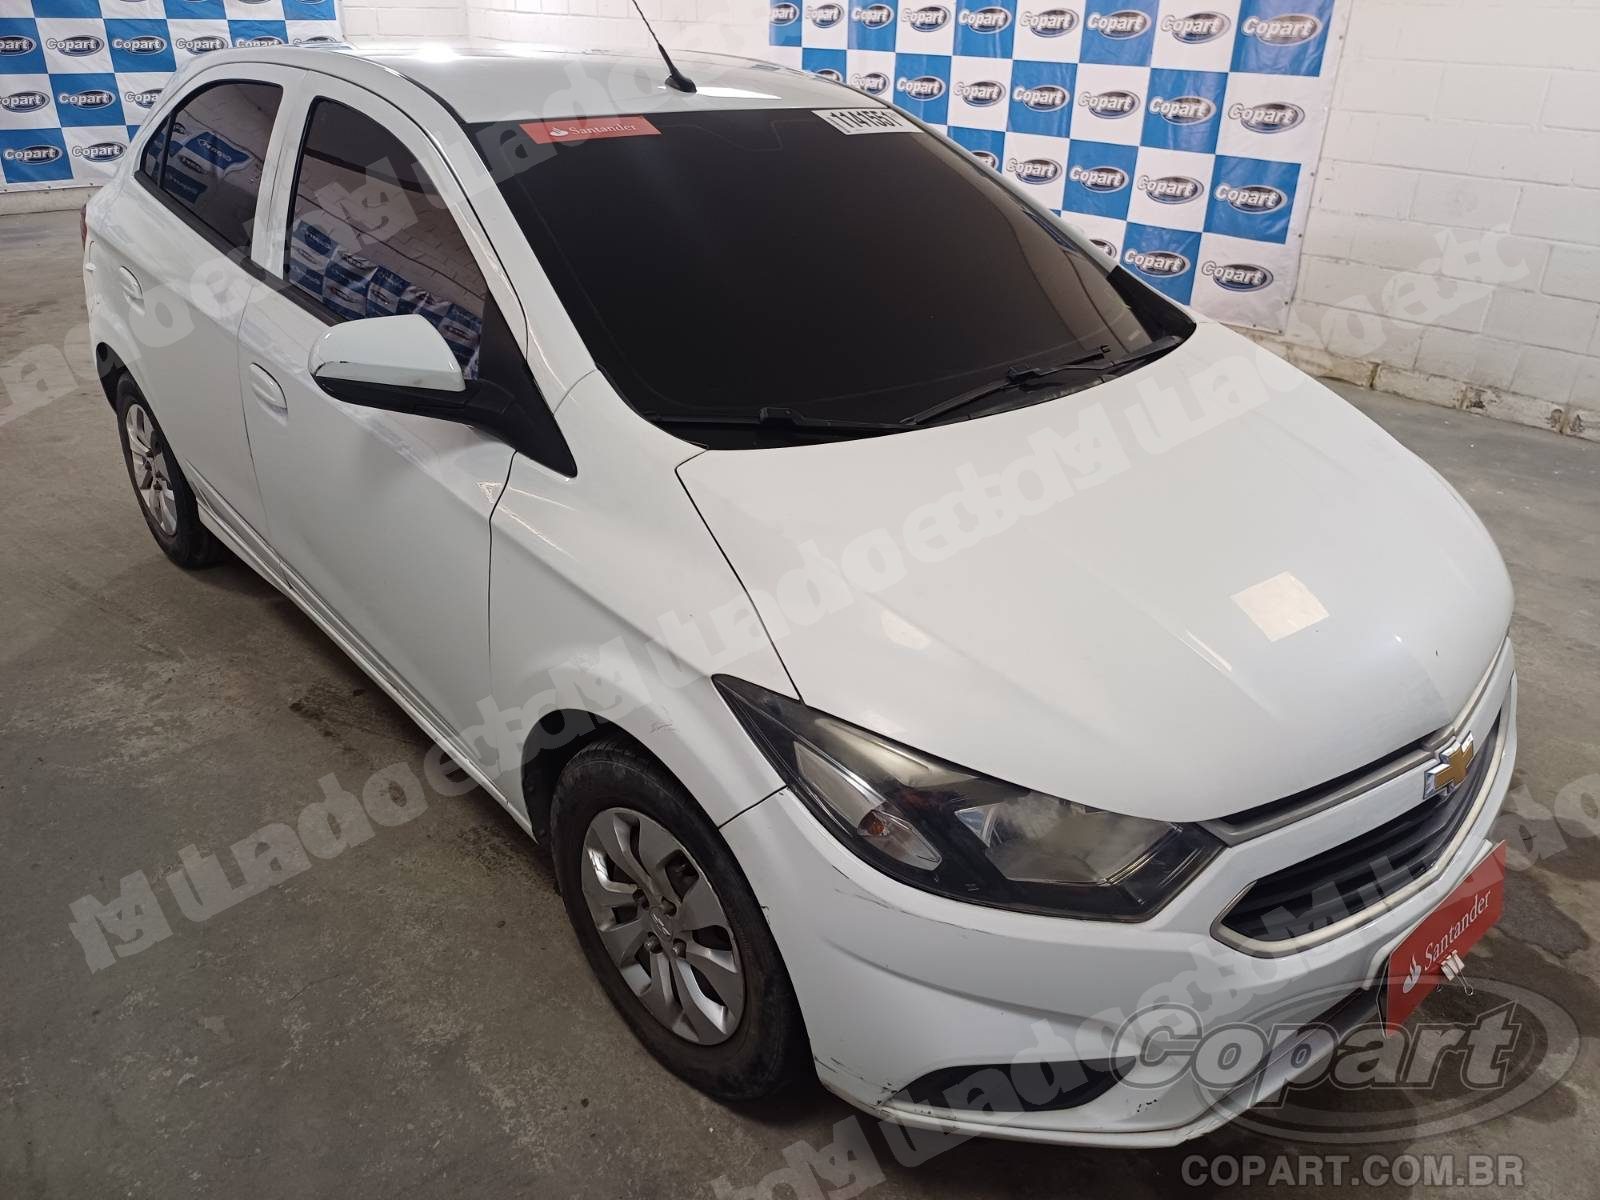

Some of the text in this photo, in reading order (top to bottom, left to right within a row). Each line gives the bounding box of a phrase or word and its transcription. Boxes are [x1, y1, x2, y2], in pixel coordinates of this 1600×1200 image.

[805, 3, 838, 22] Copart
[852, 6, 891, 24] Copart
[902, 8, 945, 26] Copart
[958, 7, 1005, 27] Copart
[1020, 10, 1071, 30] Copart
[1087, 11, 1144, 34] Copart
[1160, 14, 1220, 37] Copart
[1242, 16, 1314, 40] Copart
[46, 38, 97, 52] Copart
[112, 38, 161, 52] Copart
[176, 38, 222, 50] Copart
[851, 73, 885, 91] Copart
[896, 77, 940, 96] Copart
[953, 81, 1001, 101] Copart
[0, 94, 41, 106] opart
[59, 92, 109, 105] Copart
[1013, 85, 1063, 104] Copart
[1078, 91, 1132, 114] Copart
[1150, 96, 1207, 119] Copart
[1227, 102, 1295, 127] Copart
[570, 124, 637, 136] Santander
[4, 147, 59, 162] Copart
[72, 144, 121, 159] Copart
[1005, 158, 1056, 180] Copart
[1070, 164, 1124, 188] Copart
[1137, 174, 1195, 199] Copart
[1214, 183, 1280, 210] Copart
[1124, 247, 1184, 274] Copart
[1202, 259, 1264, 285] Copart
[1424, 890, 1491, 971] Santander
